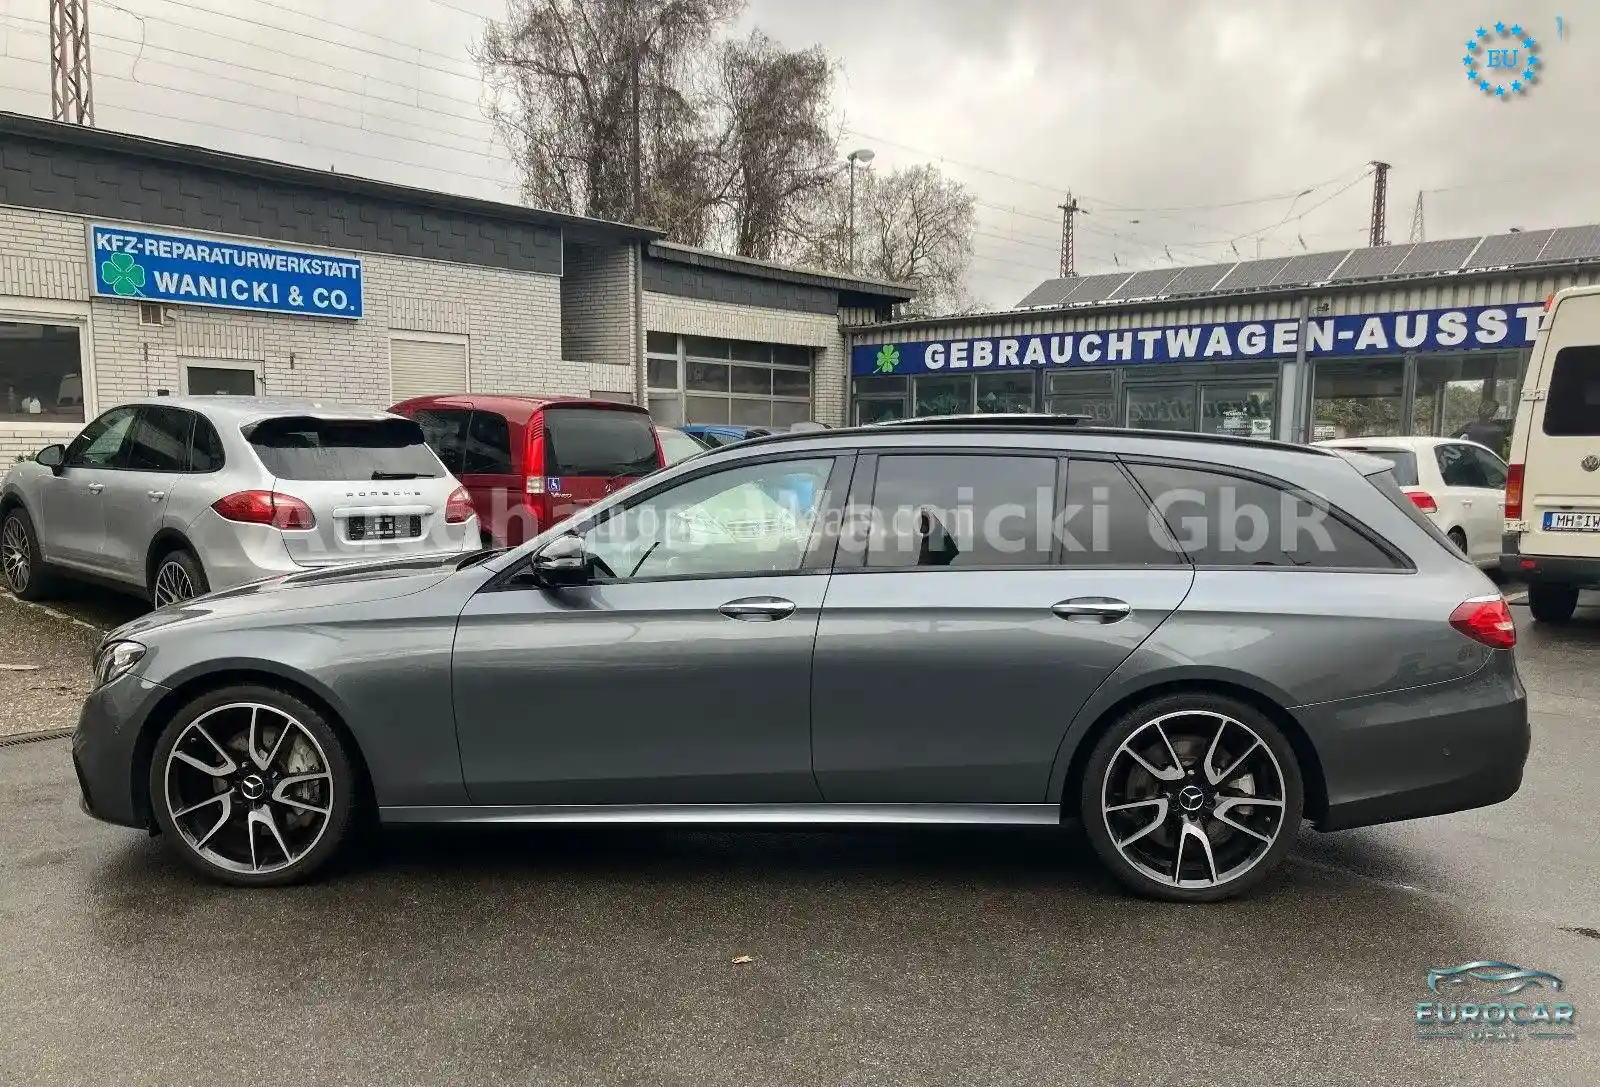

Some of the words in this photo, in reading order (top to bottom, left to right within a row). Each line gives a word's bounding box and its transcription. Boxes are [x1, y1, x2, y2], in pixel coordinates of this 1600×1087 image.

[96, 232, 359, 279] KFZ-REPARATURWERKSTATT
[154, 271, 279, 304] WANICKI
[287, 287, 305, 307] &
[312, 287, 356, 311] CO.
[924, 306, 1545, 370] GEBRAUCHTWAGEN-AUSST
[1556, 514, 1575, 528] MH
